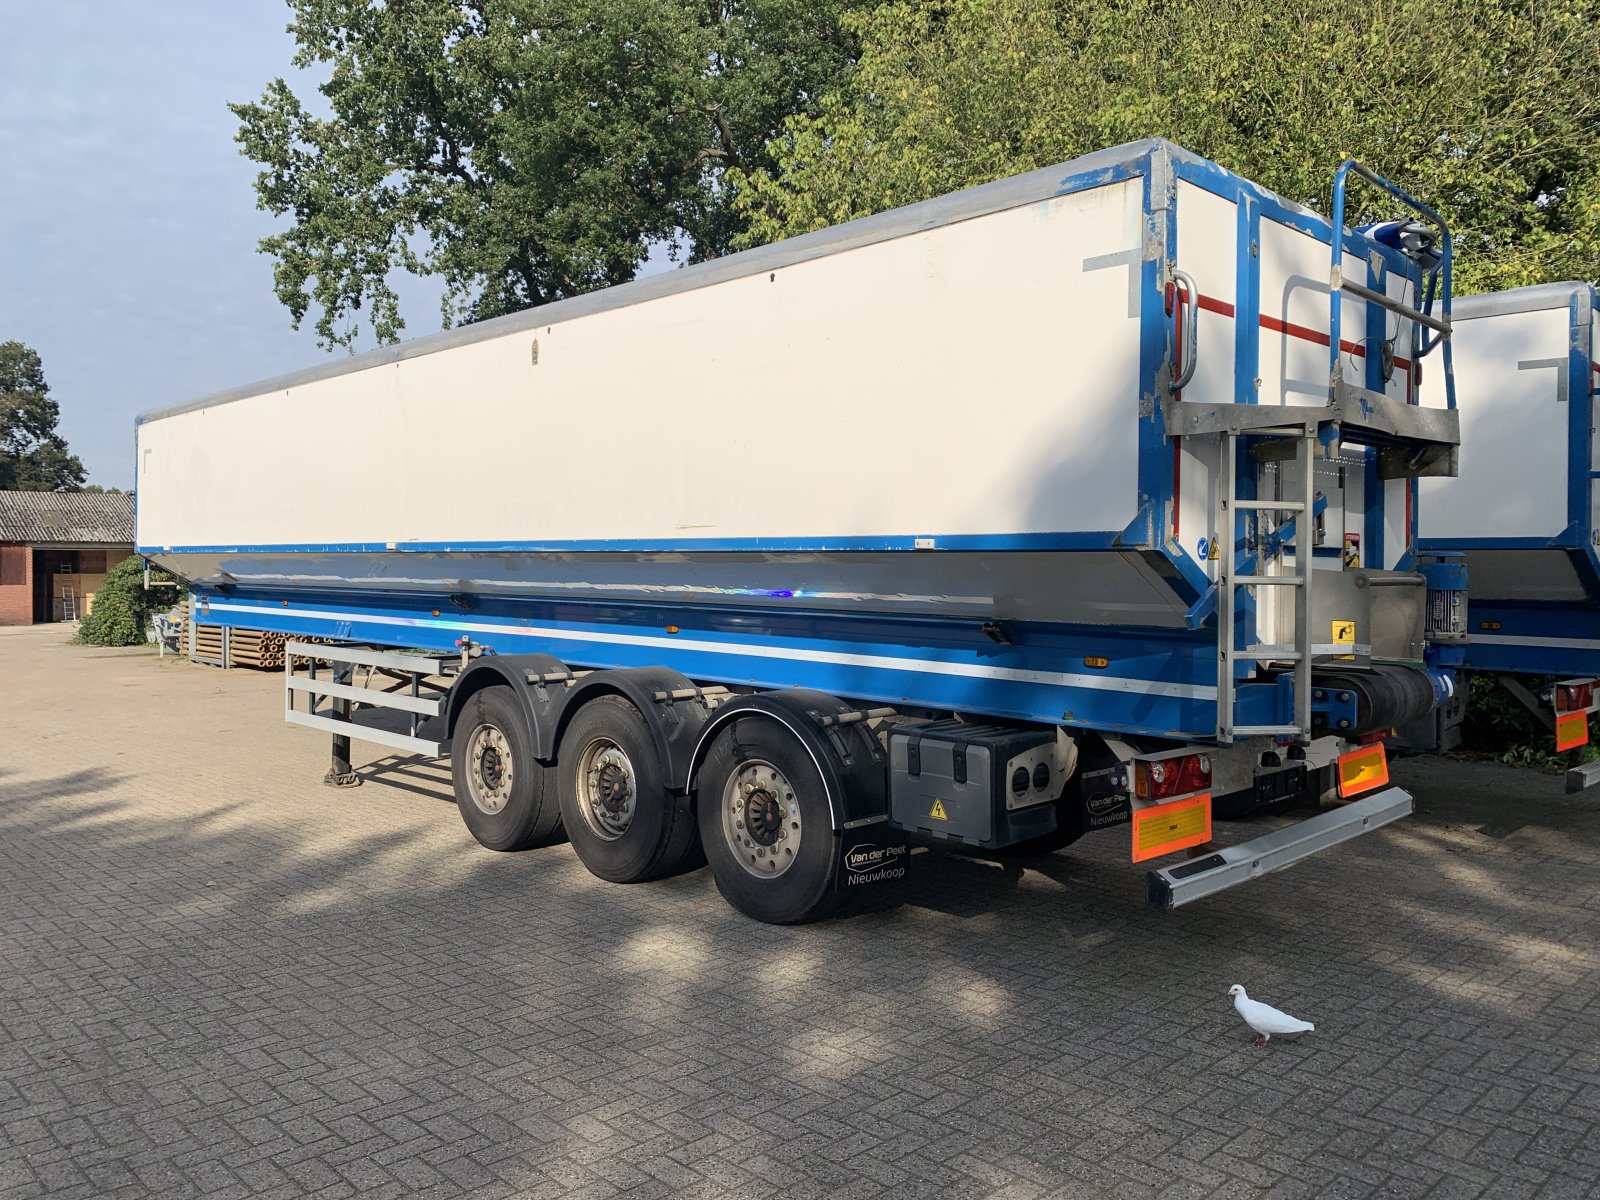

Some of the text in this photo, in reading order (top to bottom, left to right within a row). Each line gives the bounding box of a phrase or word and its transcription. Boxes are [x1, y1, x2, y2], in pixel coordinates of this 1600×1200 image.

[1090, 799, 1102, 807] Van
[1103, 796, 1113, 804] der
[1090, 811, 1127, 826] Nieuwkoop
[850, 853, 867, 863] Van
[869, 849, 885, 860] der
[886, 844, 906, 857] Peet
[848, 867, 905, 886] Nieuwkoop
